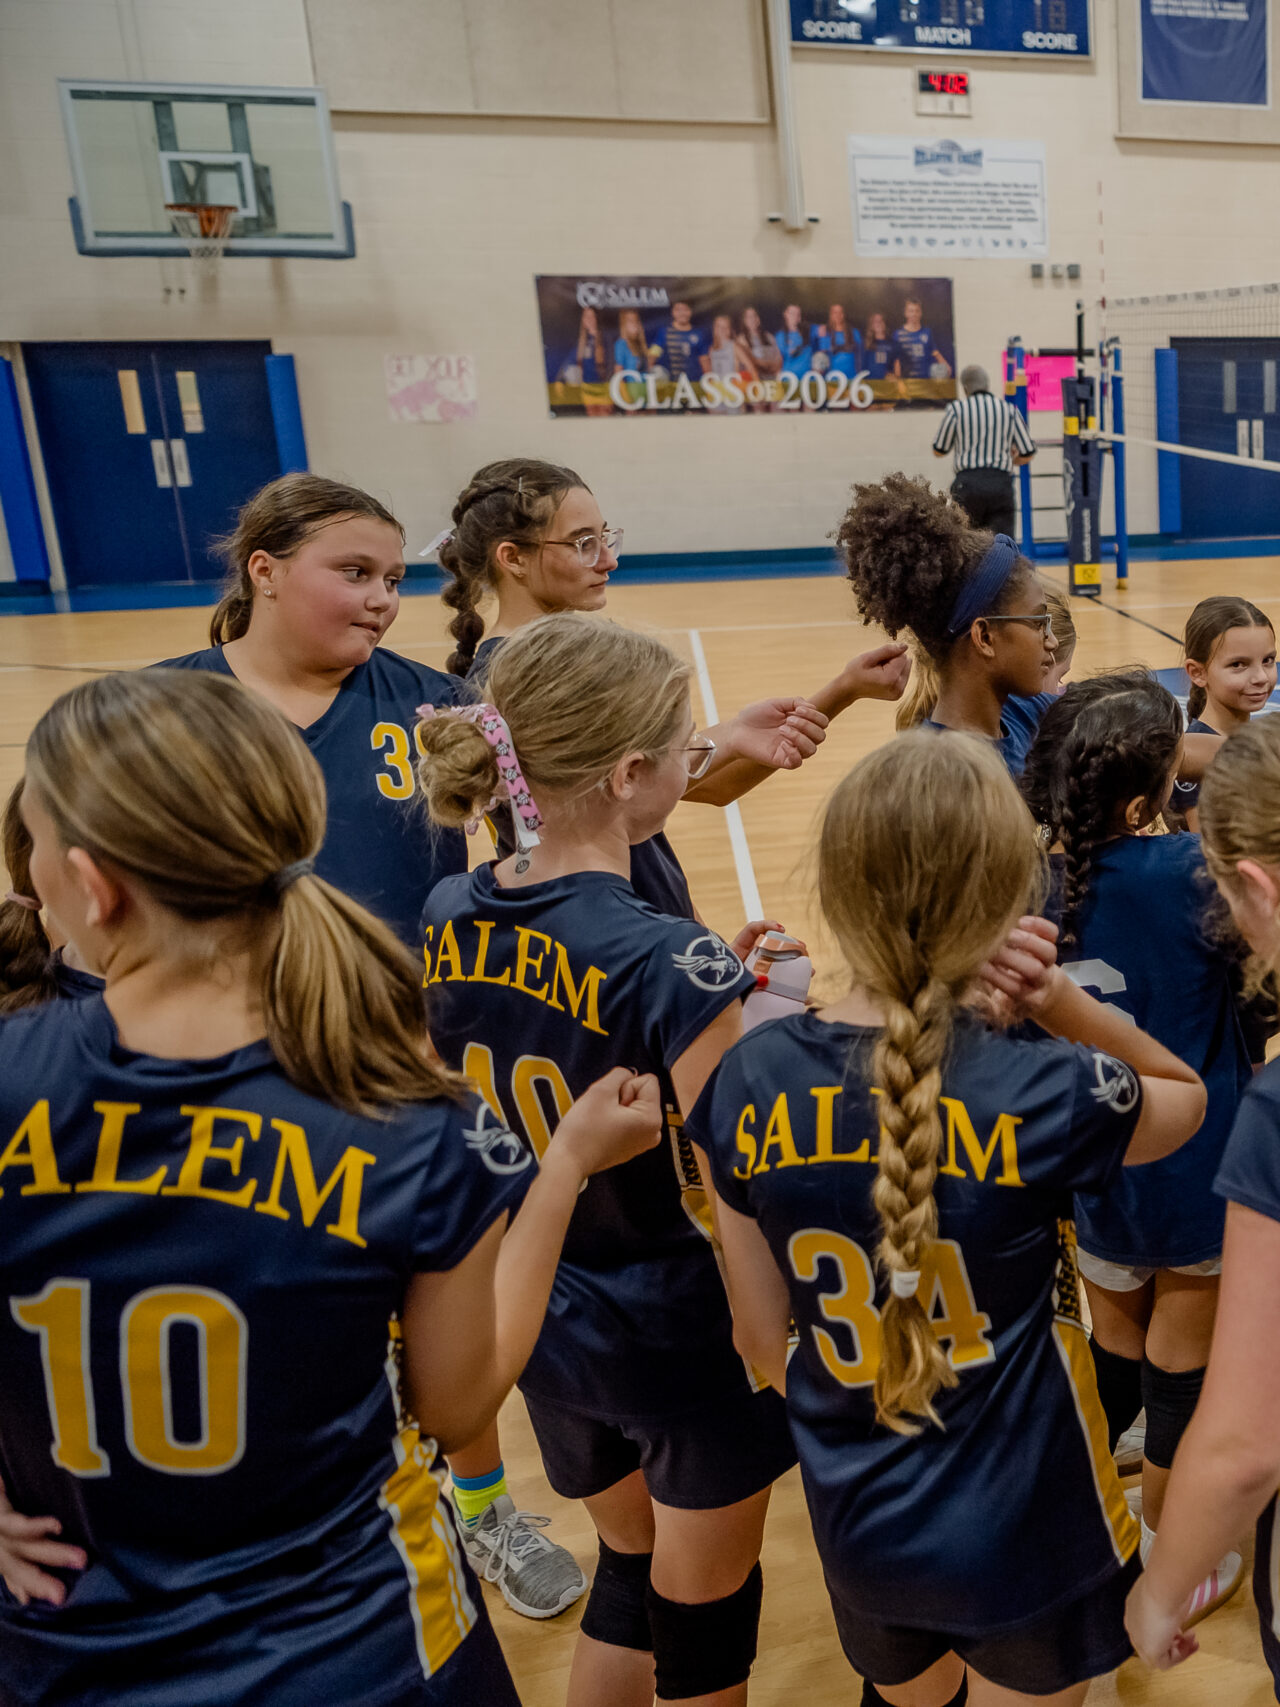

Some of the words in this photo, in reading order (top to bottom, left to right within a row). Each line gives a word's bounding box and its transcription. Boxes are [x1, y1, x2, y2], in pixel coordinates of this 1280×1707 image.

[802, 20, 862, 40] SCORE
[914, 26, 971, 46] MATCH
[1022, 31, 1078, 50] SCORE
[929, 72, 968, 94] 4:02
[609, 370, 742, 410] CLASS
[746, 380, 776, 400] OF
[777, 370, 875, 409] 2026
[370, 721, 429, 800] 3
[733, 1086, 1028, 1188] SALM
[788, 1228, 996, 1389] 34
[10, 1277, 249, 1477] 10
